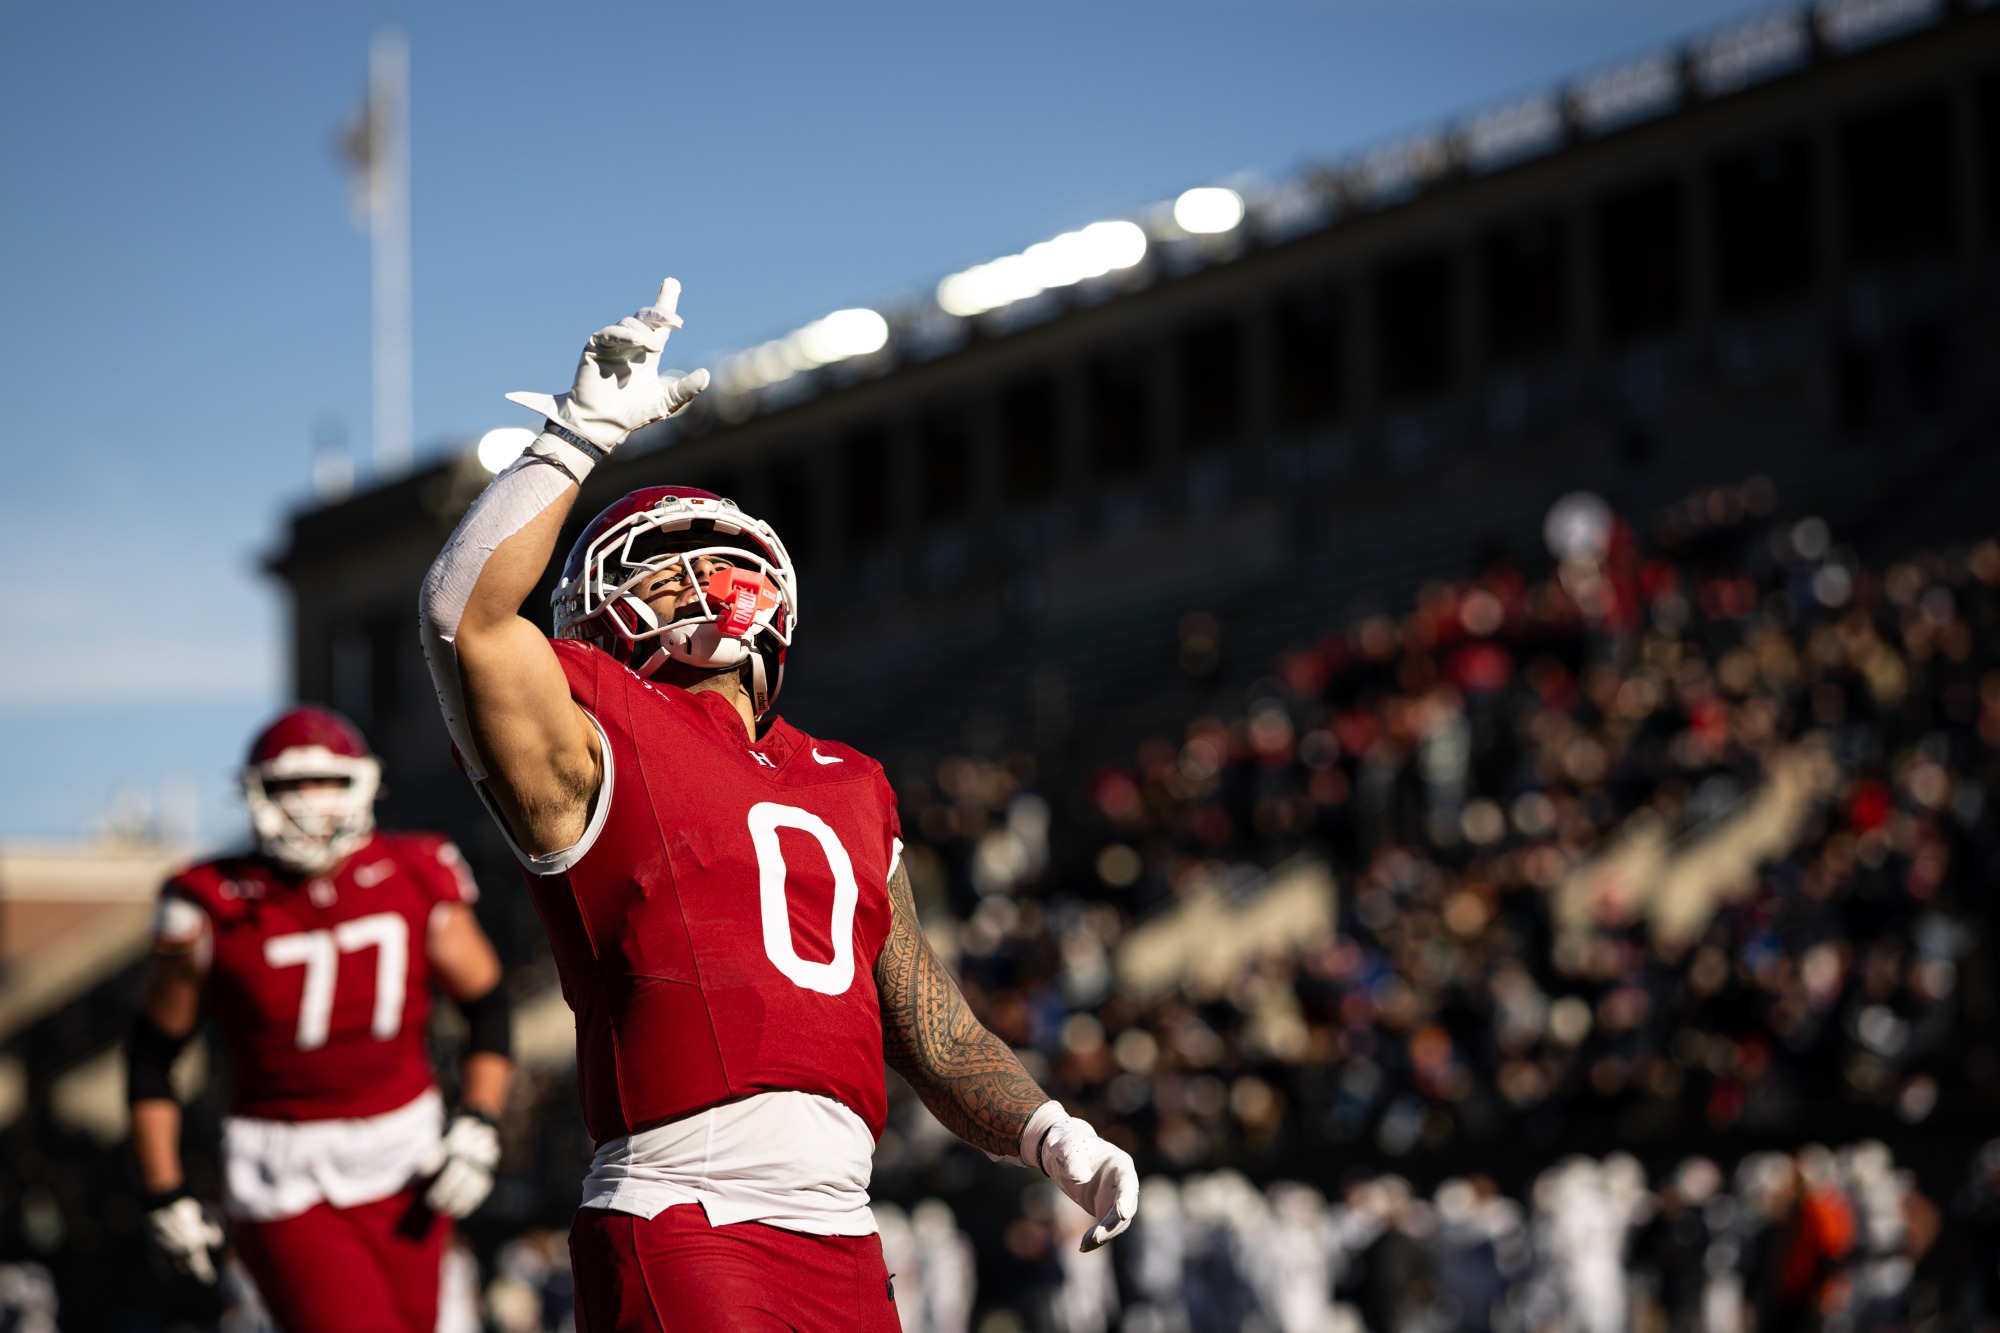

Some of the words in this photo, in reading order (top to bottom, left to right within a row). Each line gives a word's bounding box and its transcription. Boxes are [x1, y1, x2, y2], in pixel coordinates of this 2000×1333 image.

[748, 750, 777, 768] H
[747, 801, 858, 995] 0
[265, 912, 408, 1049] 77
